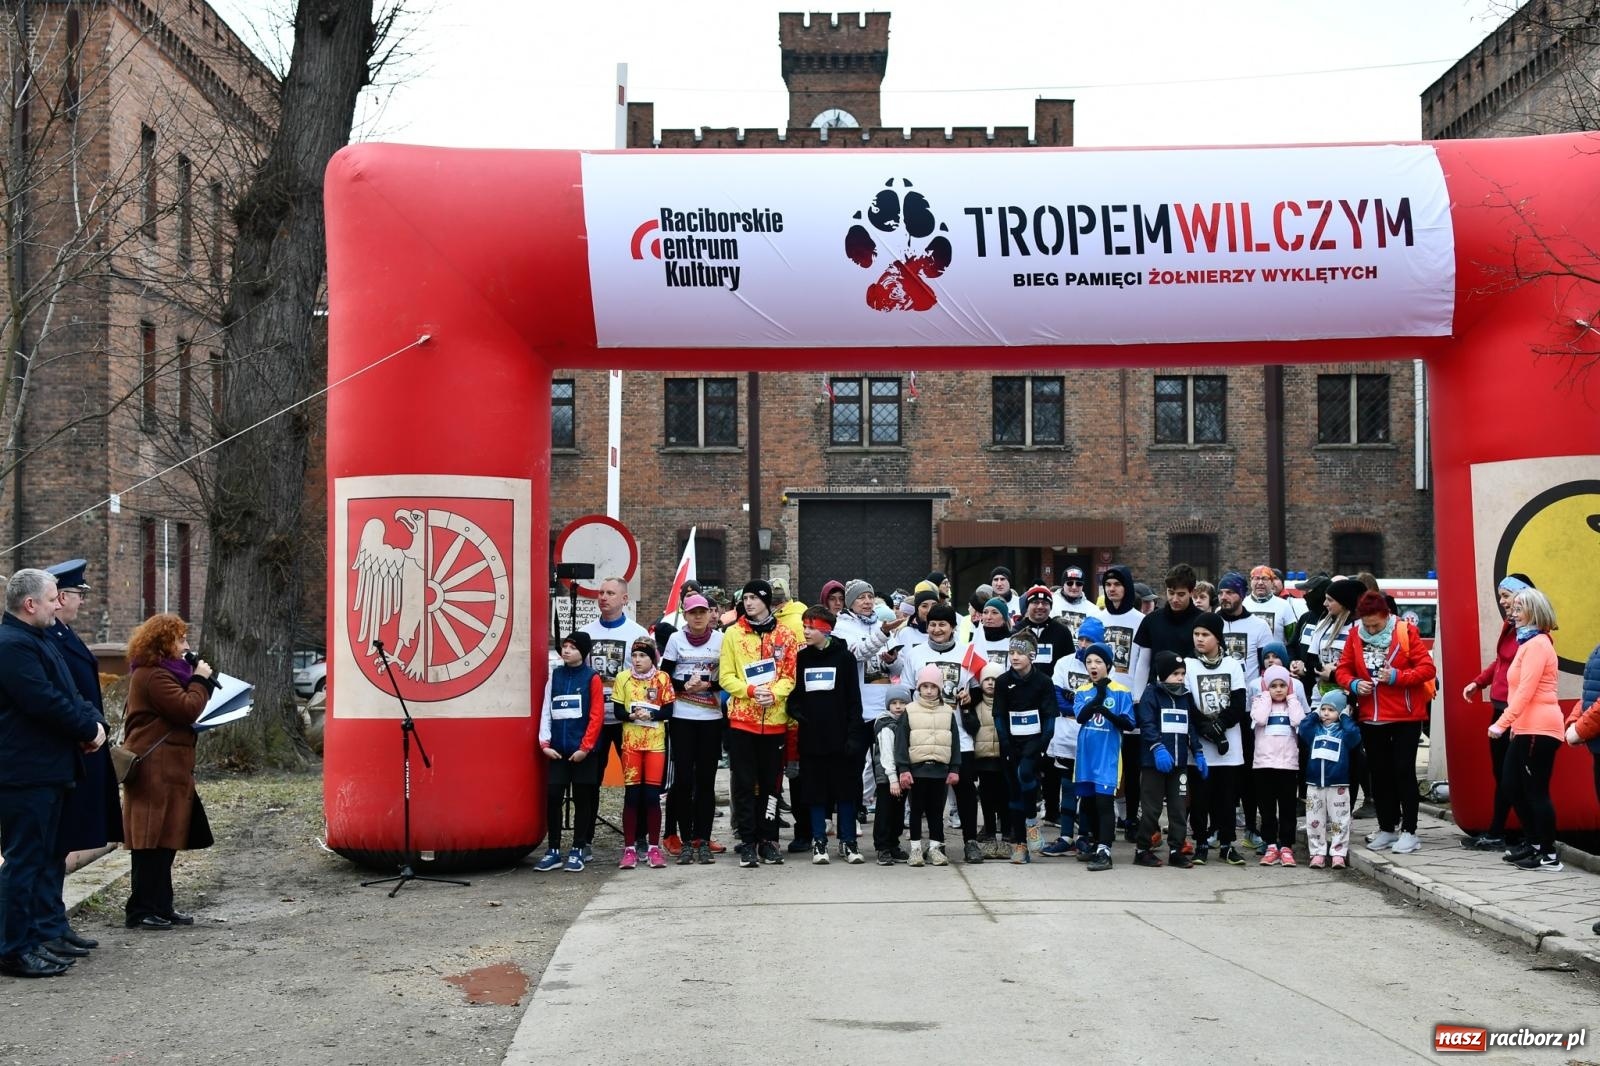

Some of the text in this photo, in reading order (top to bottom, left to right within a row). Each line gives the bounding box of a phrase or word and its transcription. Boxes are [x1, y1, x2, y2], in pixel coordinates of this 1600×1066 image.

[660, 207, 783, 232] Raciborskie
[665, 261, 740, 291] Kultury
[1013, 265, 1378, 289] BIEG PAMIĘCI ŻOŁNIERZY WYKLĘTYCH
[815, 672, 823, 680] 44
